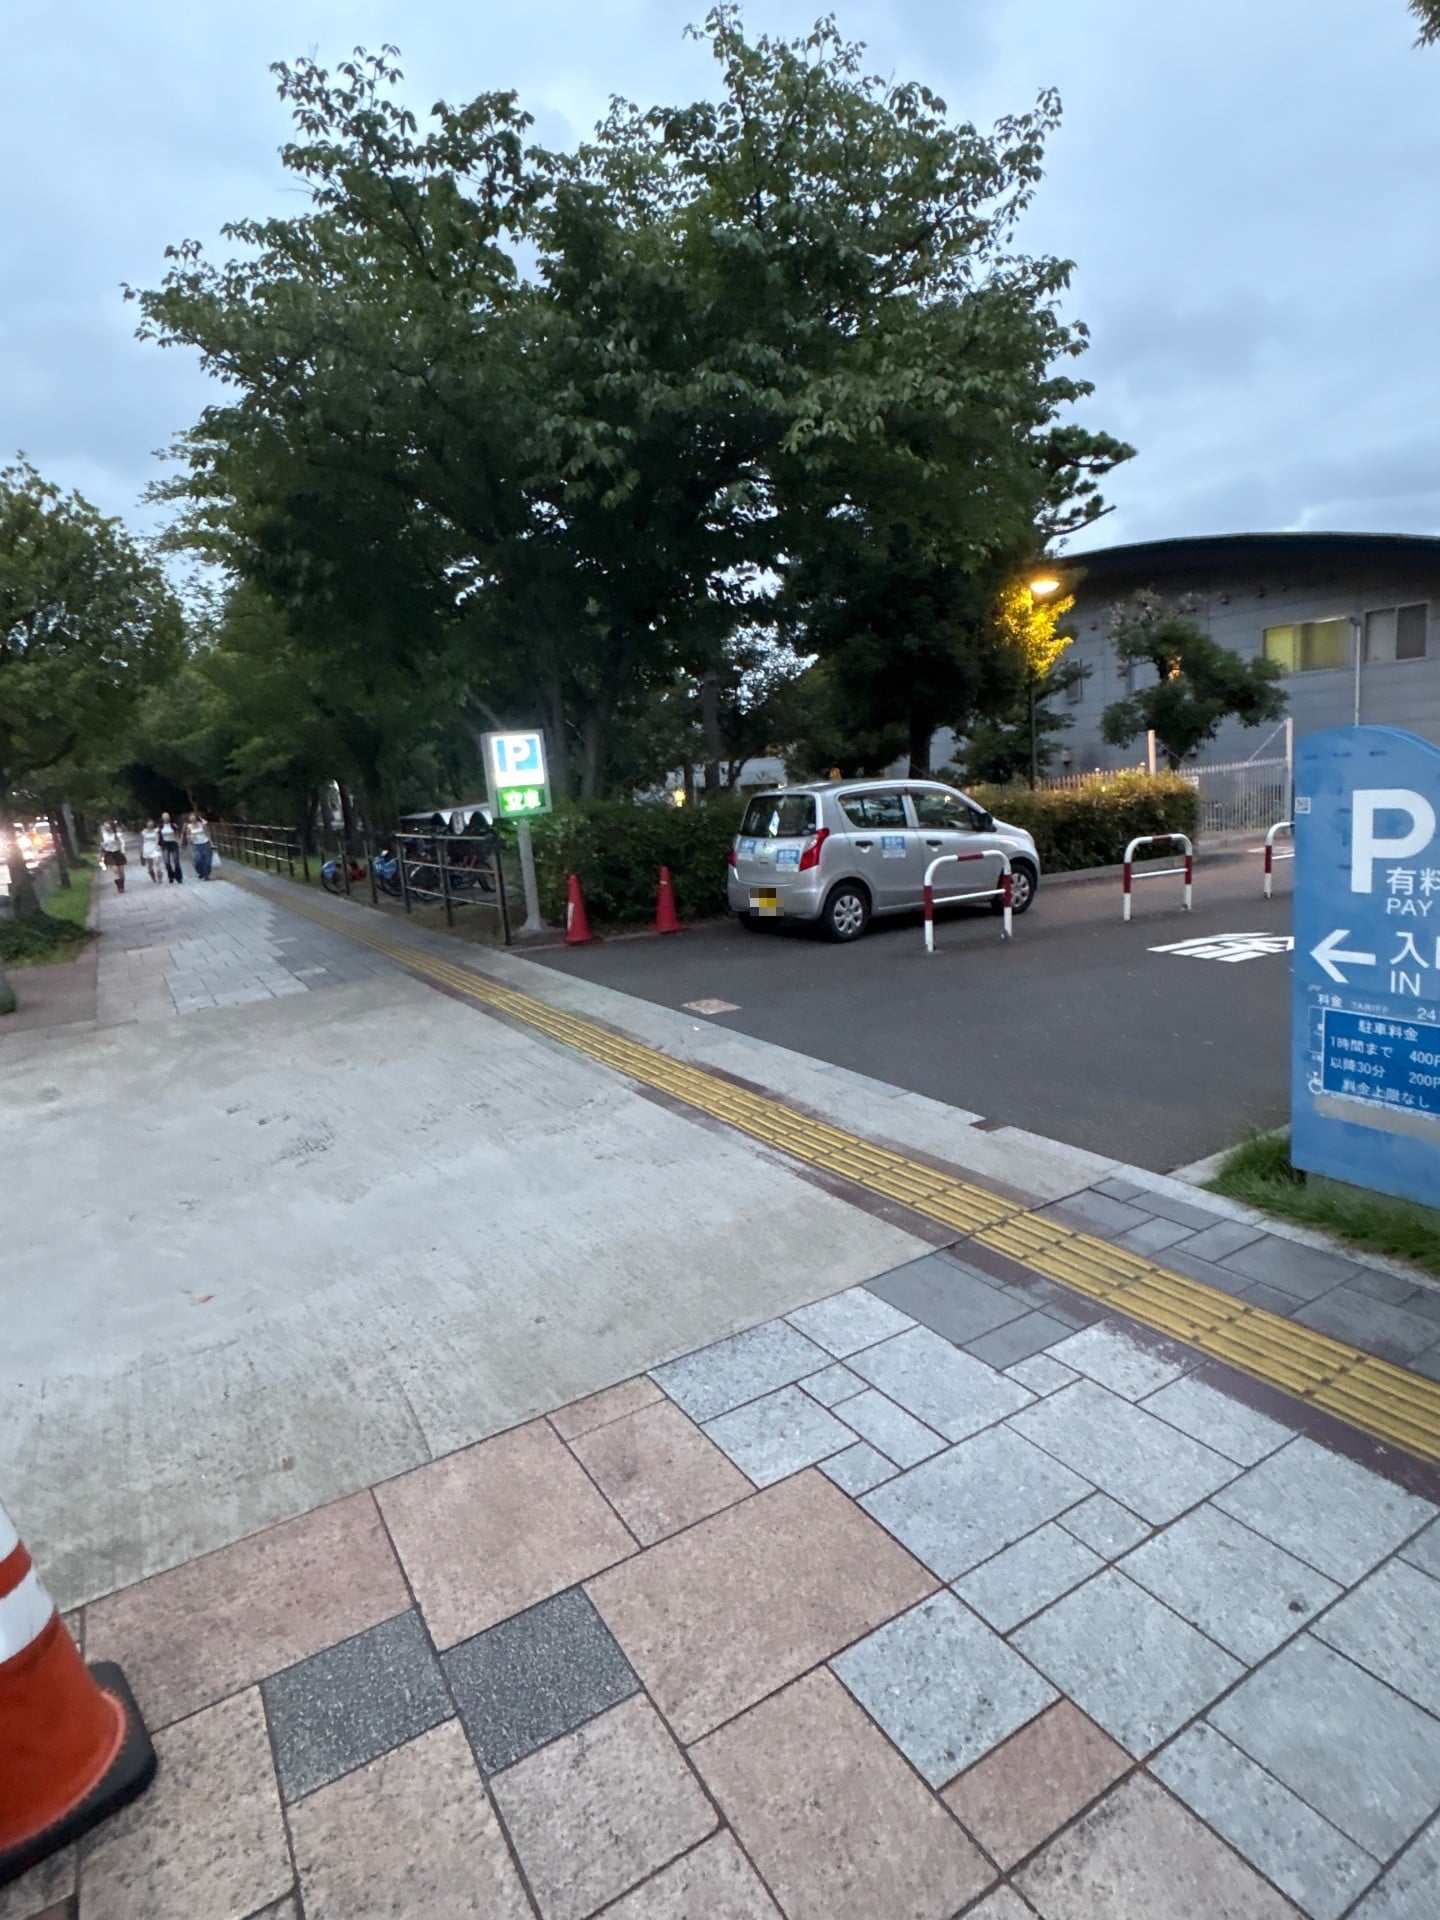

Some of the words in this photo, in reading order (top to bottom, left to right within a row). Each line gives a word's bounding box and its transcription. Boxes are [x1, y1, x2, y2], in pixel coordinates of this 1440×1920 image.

[504, 738, 531, 772] P
[1351, 788, 1436, 894] P
[1386, 867, 1440, 896] 有料
[1386, 897, 1433, 917] PAY
[1390, 931, 1440, 970] 入
[1391, 970, 1421, 996] IN
[1358, 1019, 1418, 1042] 駐車料金
[1331, 1036, 1394, 1058] 1時間まで
[1330, 1057, 1385, 1078] 以降30分
